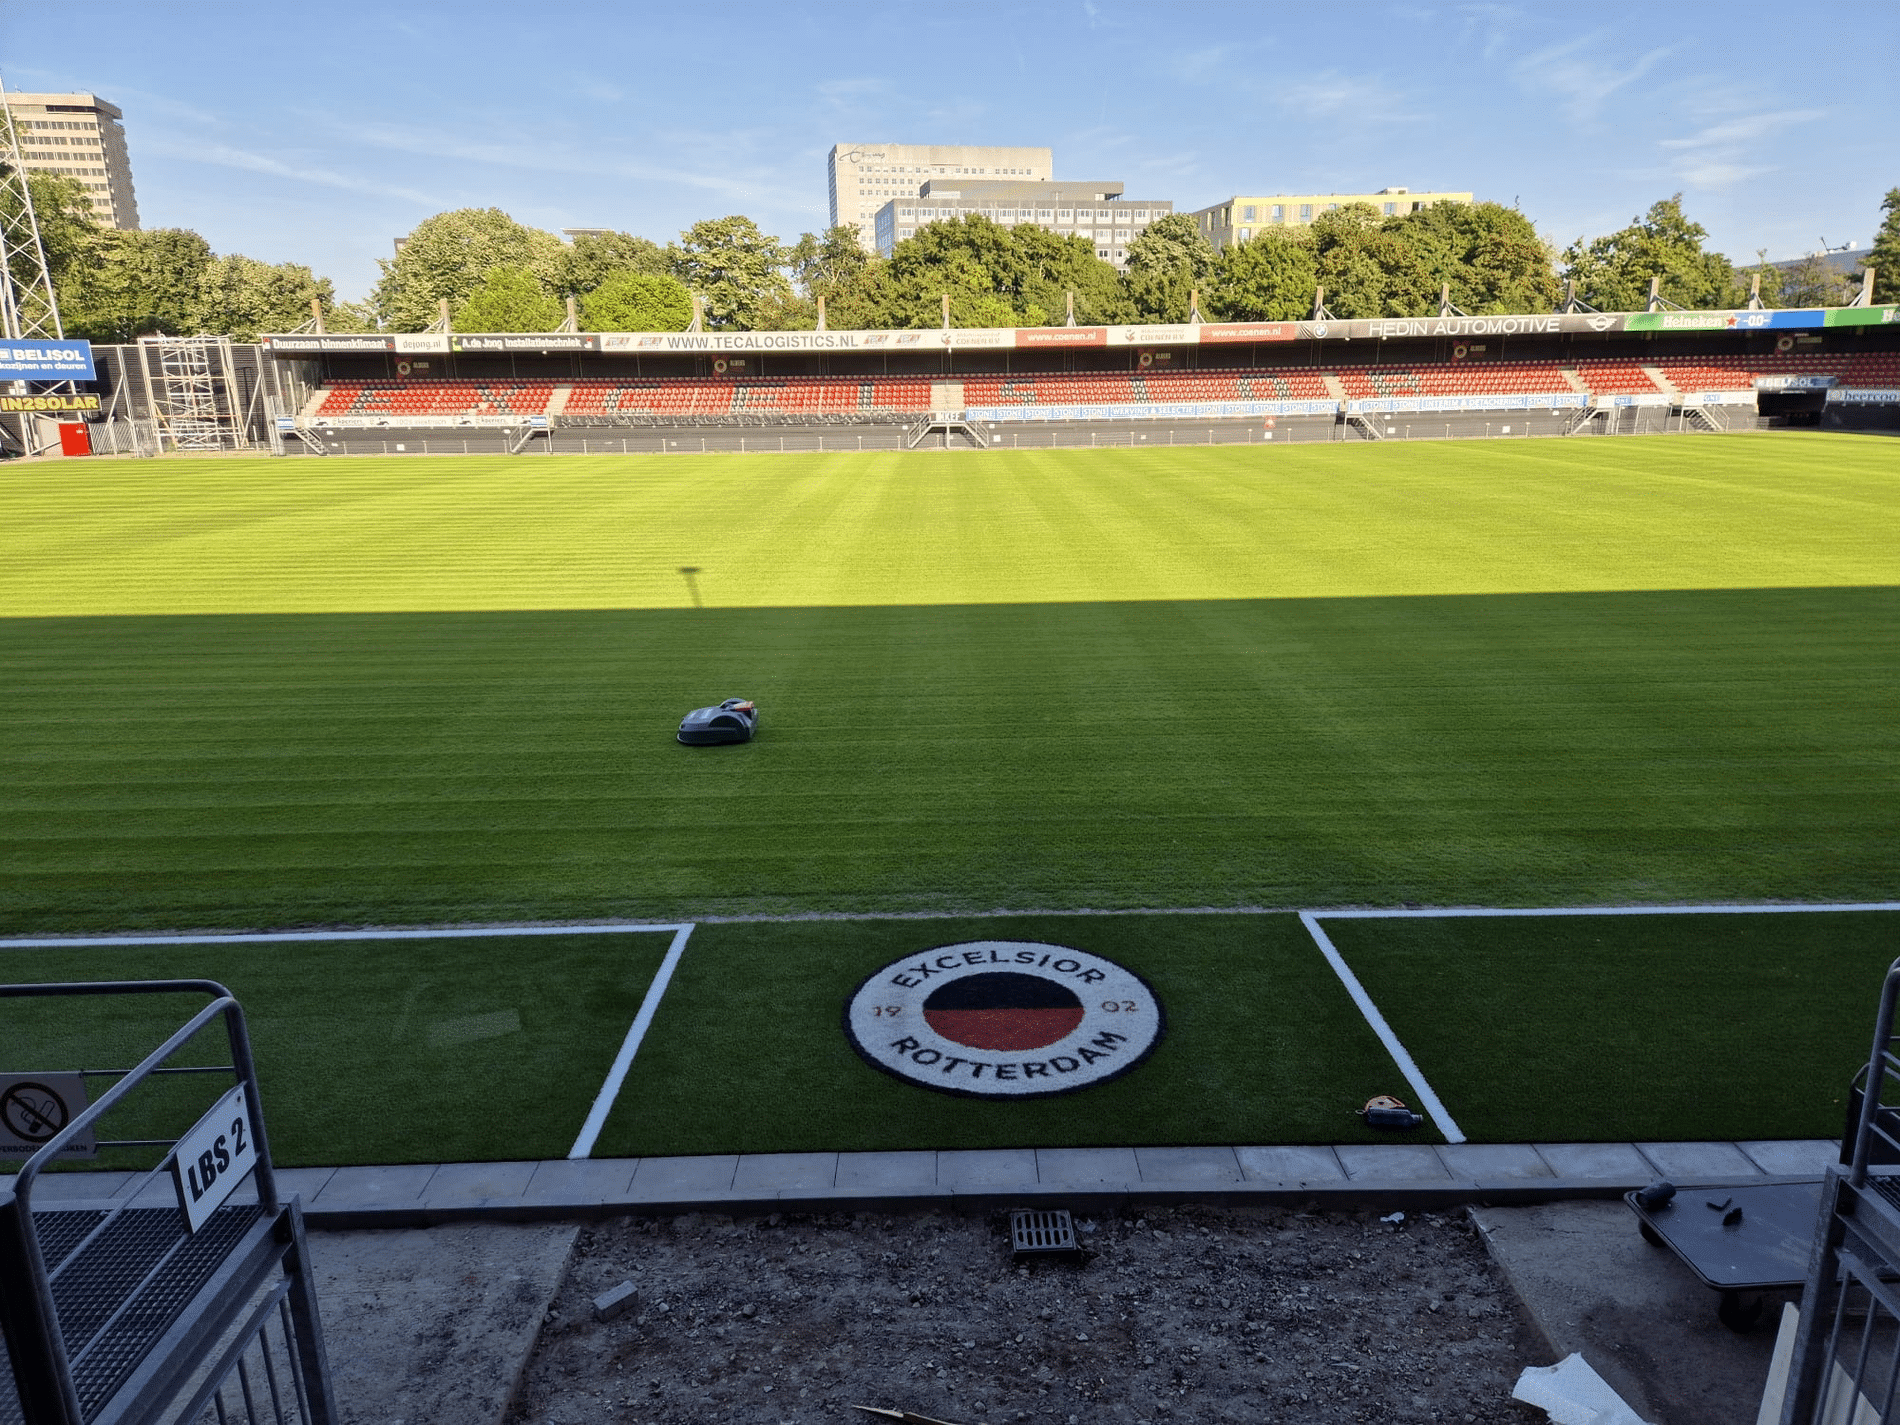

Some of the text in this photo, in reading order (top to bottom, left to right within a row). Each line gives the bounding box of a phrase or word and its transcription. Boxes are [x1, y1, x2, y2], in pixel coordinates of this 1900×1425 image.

[1663, 315, 1724, 327] Heineken
[1211, 327, 1282, 337] www.coenen.nl
[1370, 319, 1560, 336] HEDIN AUTOMOTIVE
[667, 336, 858, 349] WWW.TECALOGISTICS.NL
[1027, 331, 1097, 342] www.coenen.nl
[272, 339, 387, 349] Duurzaam binnenklimaat
[403, 340, 441, 350] dejong.nl
[482, 338, 503, 350] Jong
[504, 337, 581, 348] Installatietechniek
[12, 349, 85, 361] BELISOL
[54, 361, 87, 370] deuren
[0, 396, 99, 411] IN2SOLAR
[1527, 397, 1551, 405] STONE
[1556, 396, 1581, 404] STONE
[1159, 406, 1194, 414] SELECTIE
[890, 950, 1106, 989] EXCELSIOR
[872, 1006, 901, 1017] 19
[1101, 1000, 1139, 1012] 02
[890, 1030, 1127, 1080] ROTTERDAM
[187, 1116, 247, 1203] LBS 2
